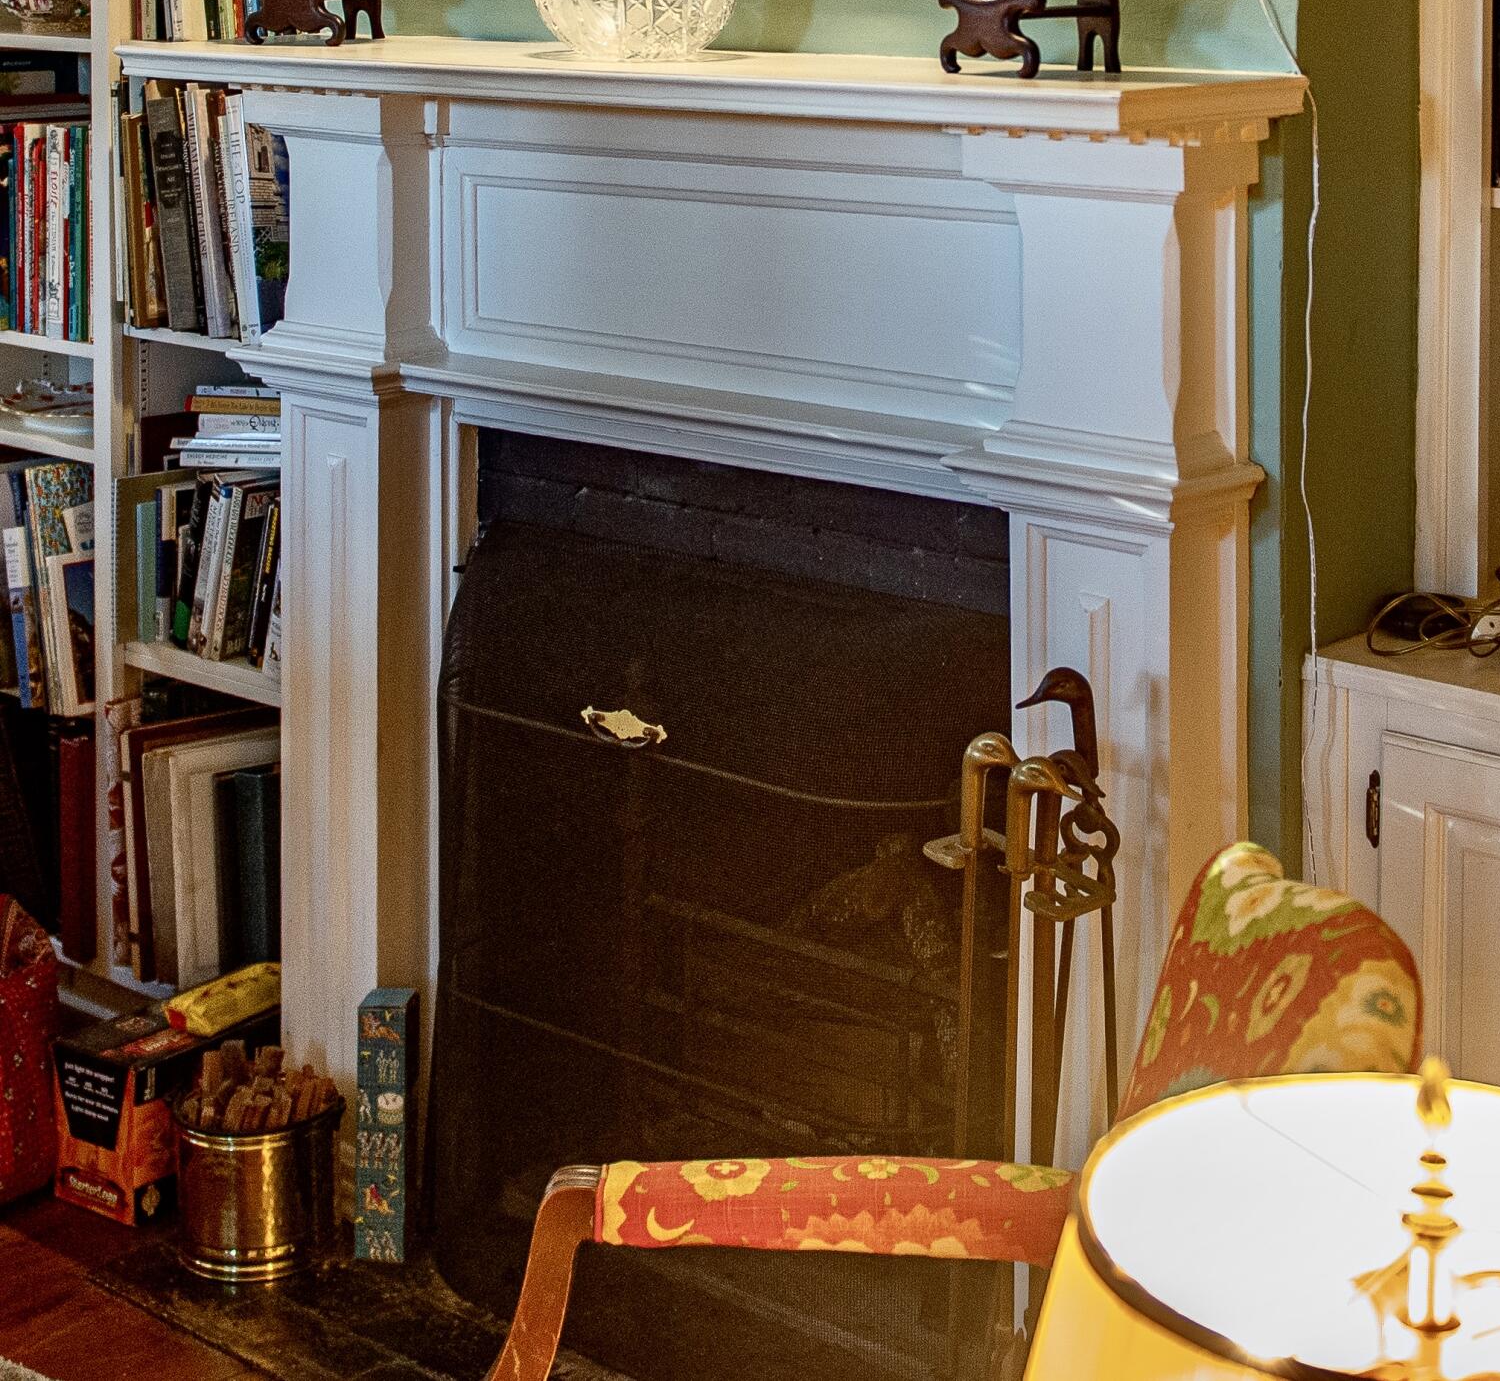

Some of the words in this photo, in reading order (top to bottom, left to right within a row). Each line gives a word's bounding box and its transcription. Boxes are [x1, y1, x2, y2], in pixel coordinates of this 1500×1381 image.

[182, 140, 191, 174] Sargent
[187, 112, 199, 164] WILLIAM
[230, 131, 240, 159] LIFE
[192, 166, 204, 216] MERRITT
[234, 171, 245, 204] TOP
[196, 217, 208, 259] CHASE
[227, 198, 240, 254] IRELAND
